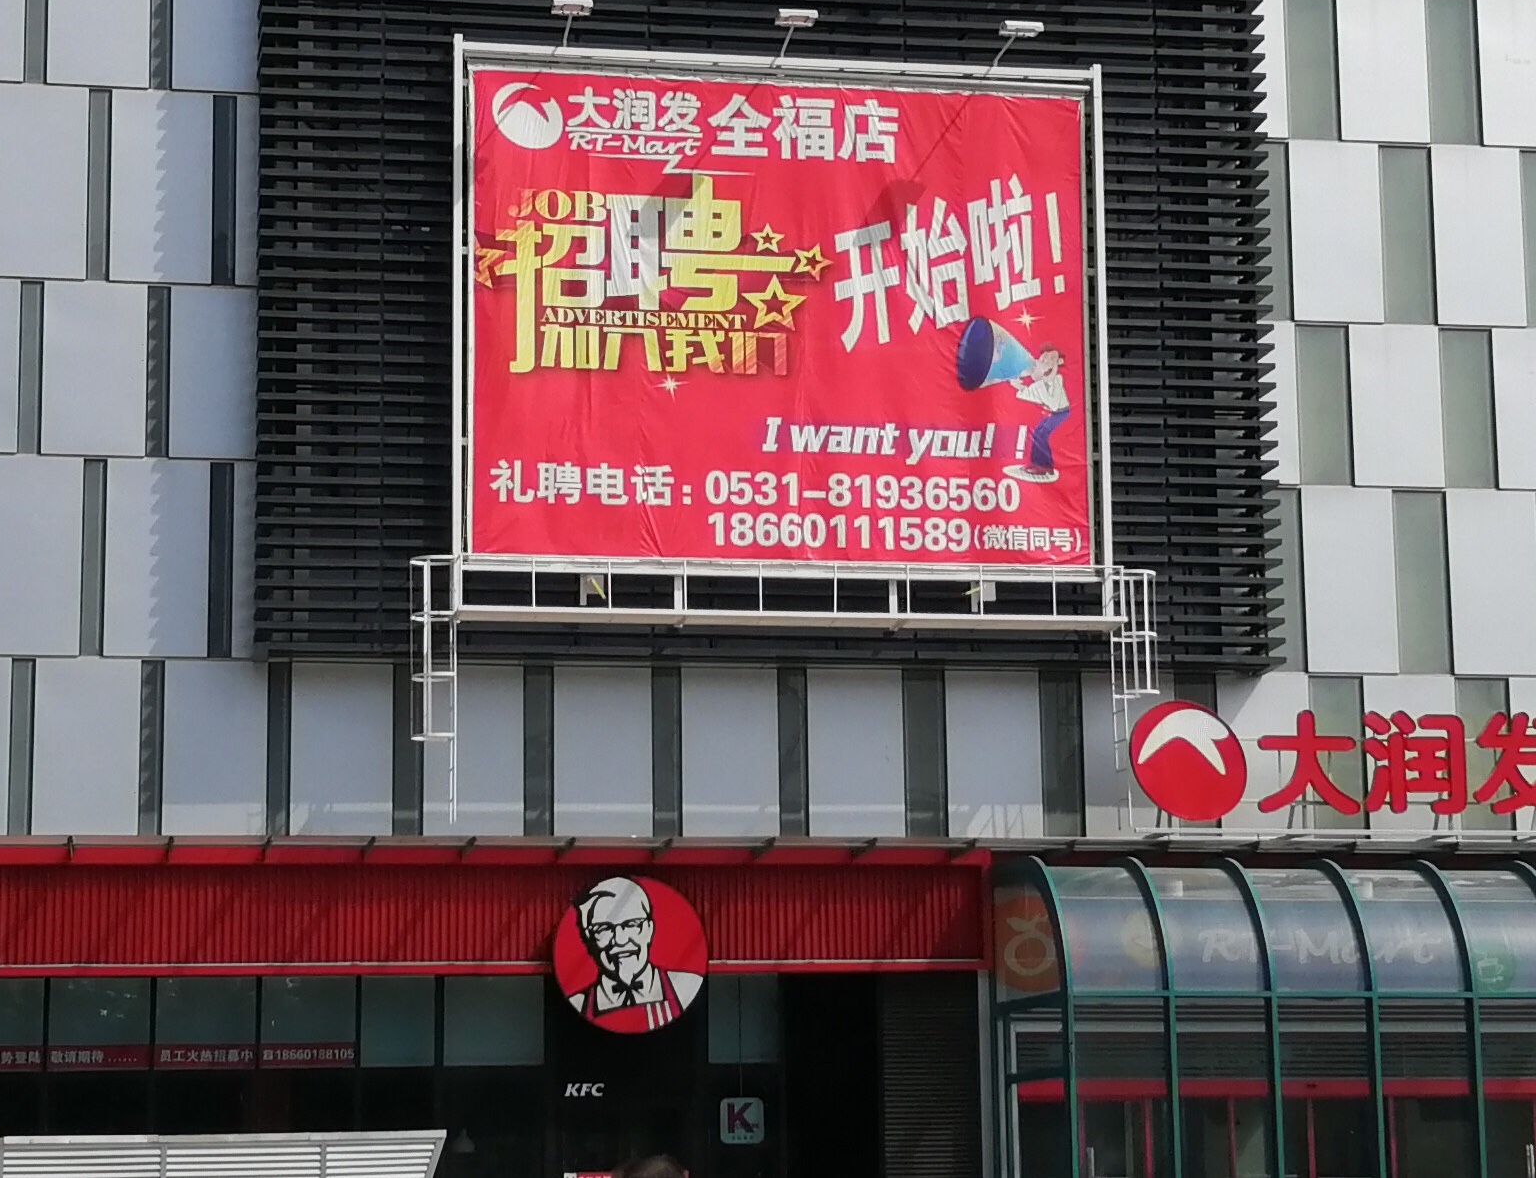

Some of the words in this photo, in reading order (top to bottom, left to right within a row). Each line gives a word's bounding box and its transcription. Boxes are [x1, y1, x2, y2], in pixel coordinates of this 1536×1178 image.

[566, 85, 703, 131] 大润发
[708, 93, 900, 164] 全福店
[567, 131, 703, 157] RT-Mart
[507, 188, 608, 222] JOB
[494, 174, 797, 375] 招聘
[539, 307, 747, 331] ADVERTISEMENT
[539, 324, 788, 377] 加入我们
[761, 416, 783, 454] I
[789, 421, 900, 456] want
[905, 422, 996, 466] you!
[564, 1082, 605, 1098] KFC
